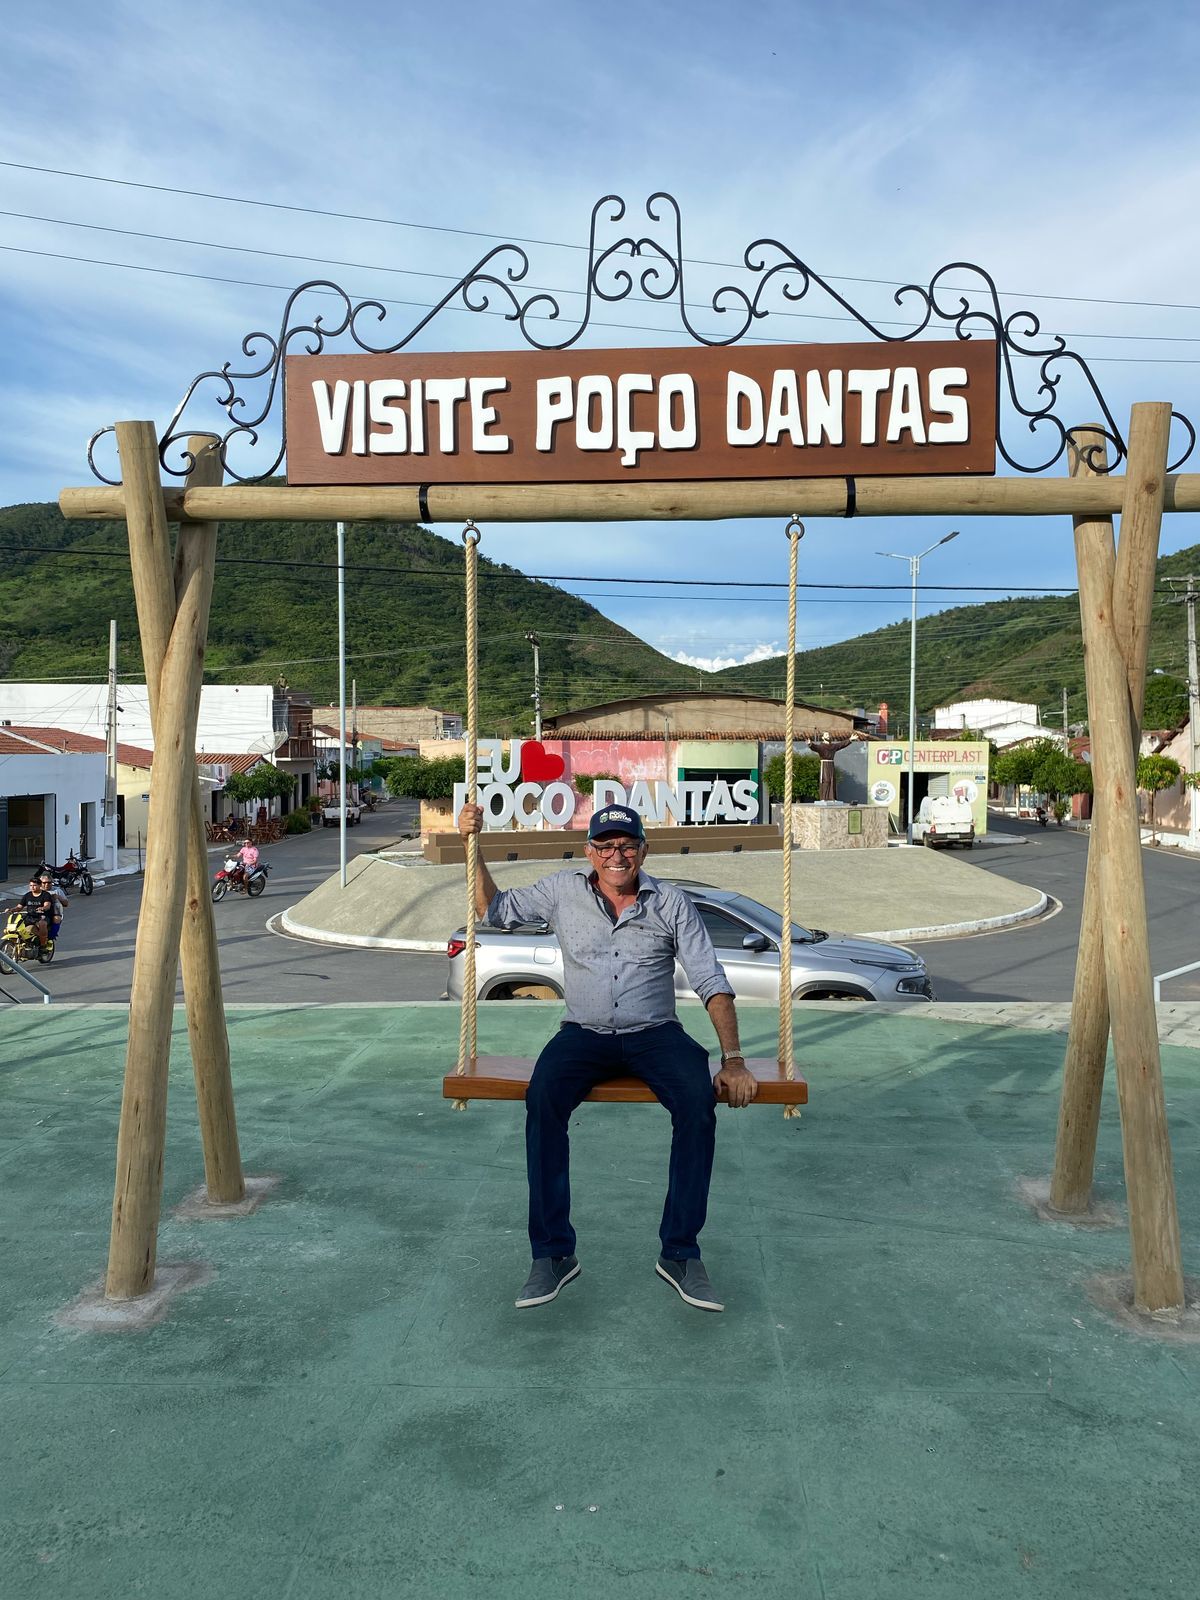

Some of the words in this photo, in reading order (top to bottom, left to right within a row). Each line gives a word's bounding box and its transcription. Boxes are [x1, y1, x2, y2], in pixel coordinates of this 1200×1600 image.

[312, 377, 508, 454] VISITE
[536, 373, 697, 466] POÇO
[727, 367, 969, 446] DANTAS
[465, 738, 521, 784] EU
[593, 779, 759, 822] DANTAS
